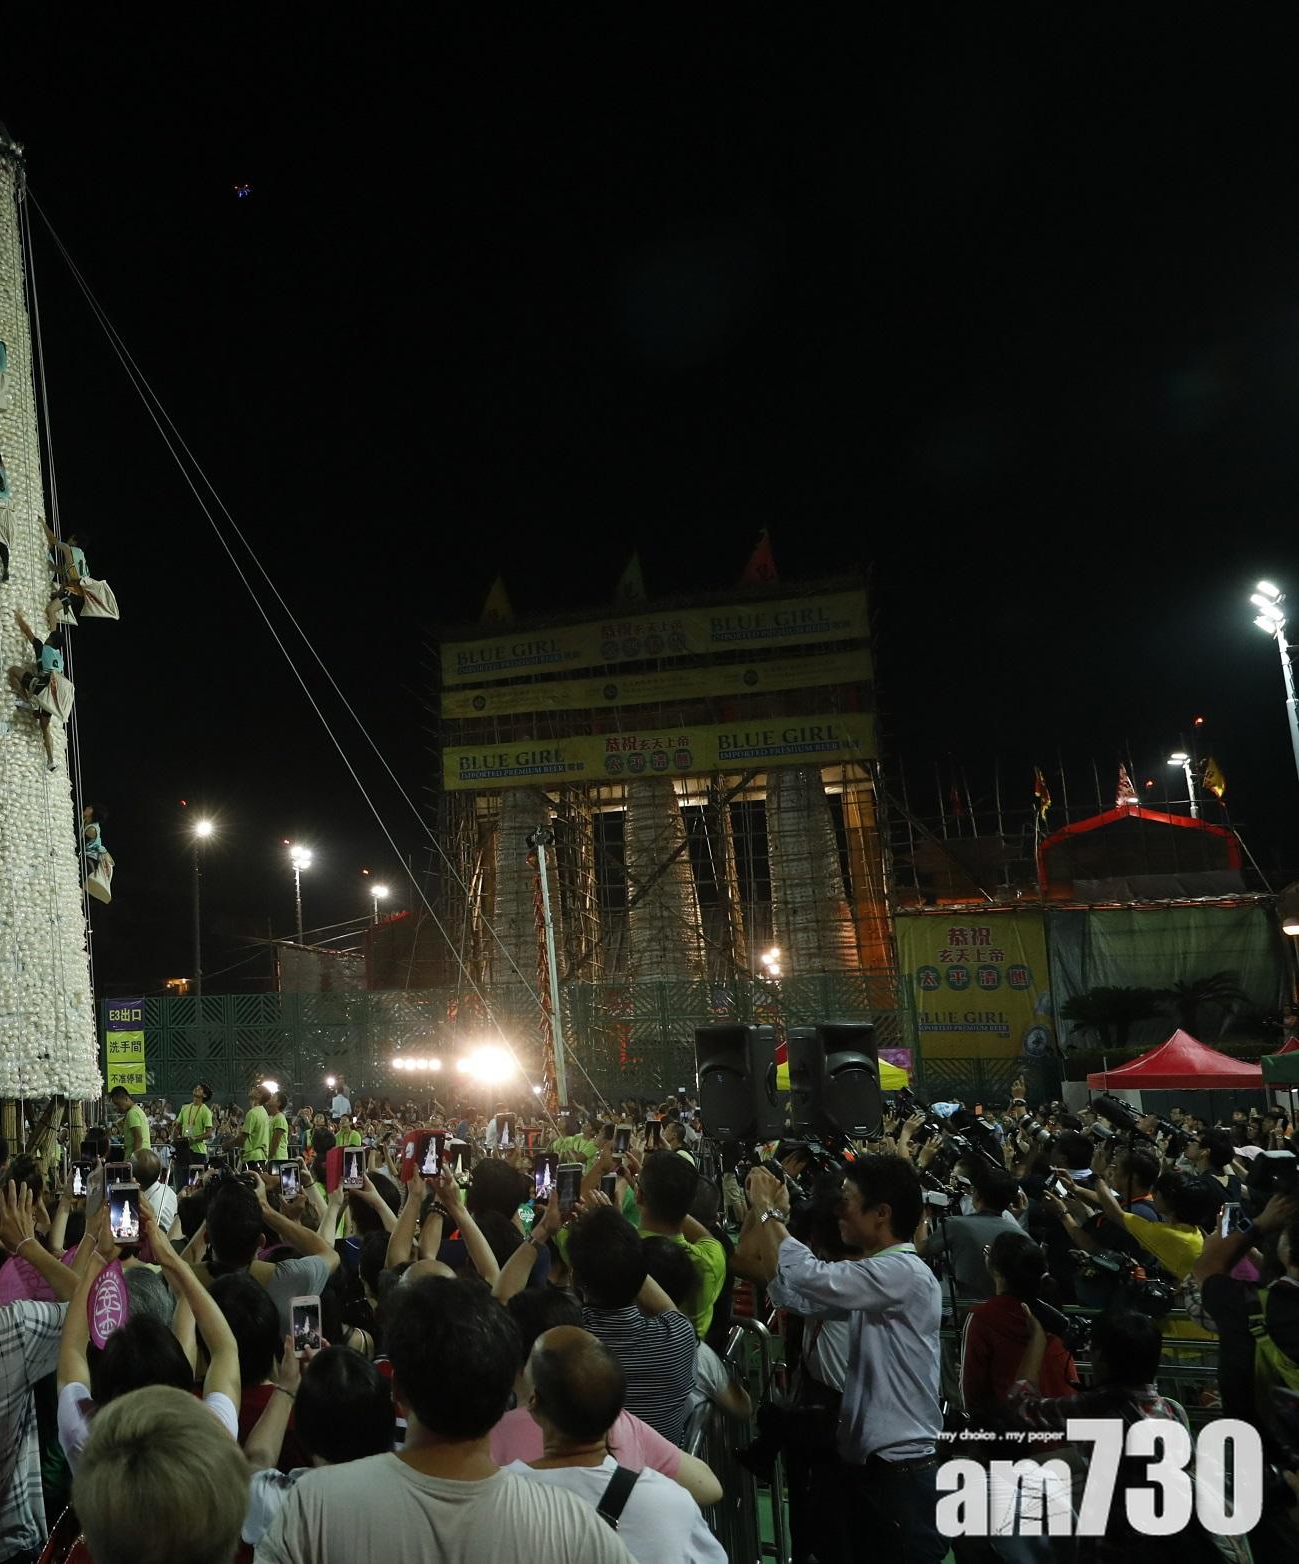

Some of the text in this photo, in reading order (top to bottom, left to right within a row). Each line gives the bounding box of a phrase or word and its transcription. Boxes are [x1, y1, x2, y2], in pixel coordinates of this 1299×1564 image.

[711, 614, 767, 631] BLUE
[774, 607, 829, 626] GIRL
[458, 639, 559, 664] BLUE GIRL
[606, 736, 689, 752] 恭祝玄天上帝
[718, 725, 839, 750] BLUE GIRL
[720, 747, 769, 760] IMPORTED
[770, 744, 813, 756] PREMIUM
[815, 741, 839, 751] BEER
[460, 749, 565, 770] BLUE GIRL
[462, 769, 502, 779] IMPORTED
[503, 766, 542, 776] PREMIUM
[543, 764, 565, 773] BEER
[948, 927, 991, 946] 恭祝
[939, 949, 1006, 963] 玄天上帝
[109, 1008, 142, 1022] E3出口
[920, 1011, 1008, 1023] LUE GIRL
[110, 1041, 142, 1053] 洗手間
[110, 1074, 143, 1084] 不准停留
